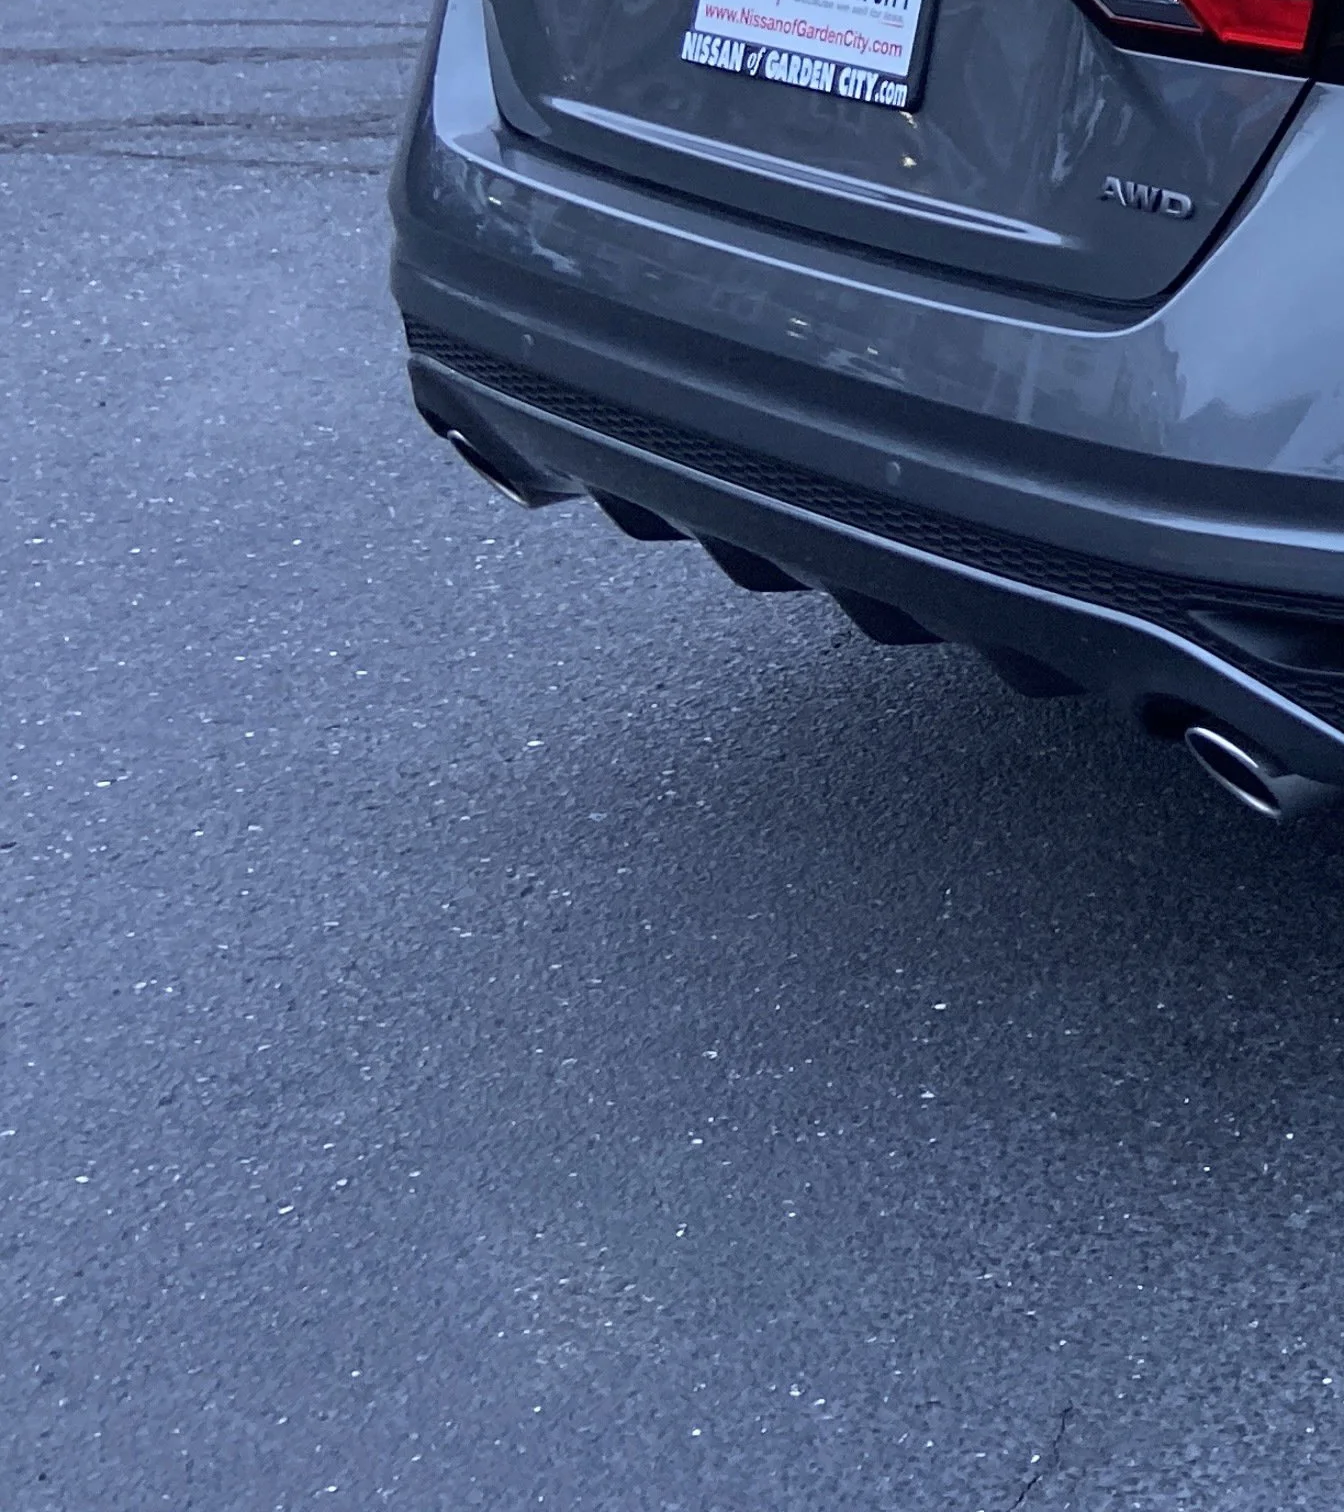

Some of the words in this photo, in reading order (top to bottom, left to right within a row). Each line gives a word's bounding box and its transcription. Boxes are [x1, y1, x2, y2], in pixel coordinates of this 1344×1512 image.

[704, 3, 903, 58] www.NissanofGardenCity.com
[681, 31, 745, 72] NISSAN
[746, 46, 765, 76] of
[764, 50, 836, 92] GARDEN
[838, 68, 908, 107] CITY.com
[1101, 175, 1192, 218] AWD
